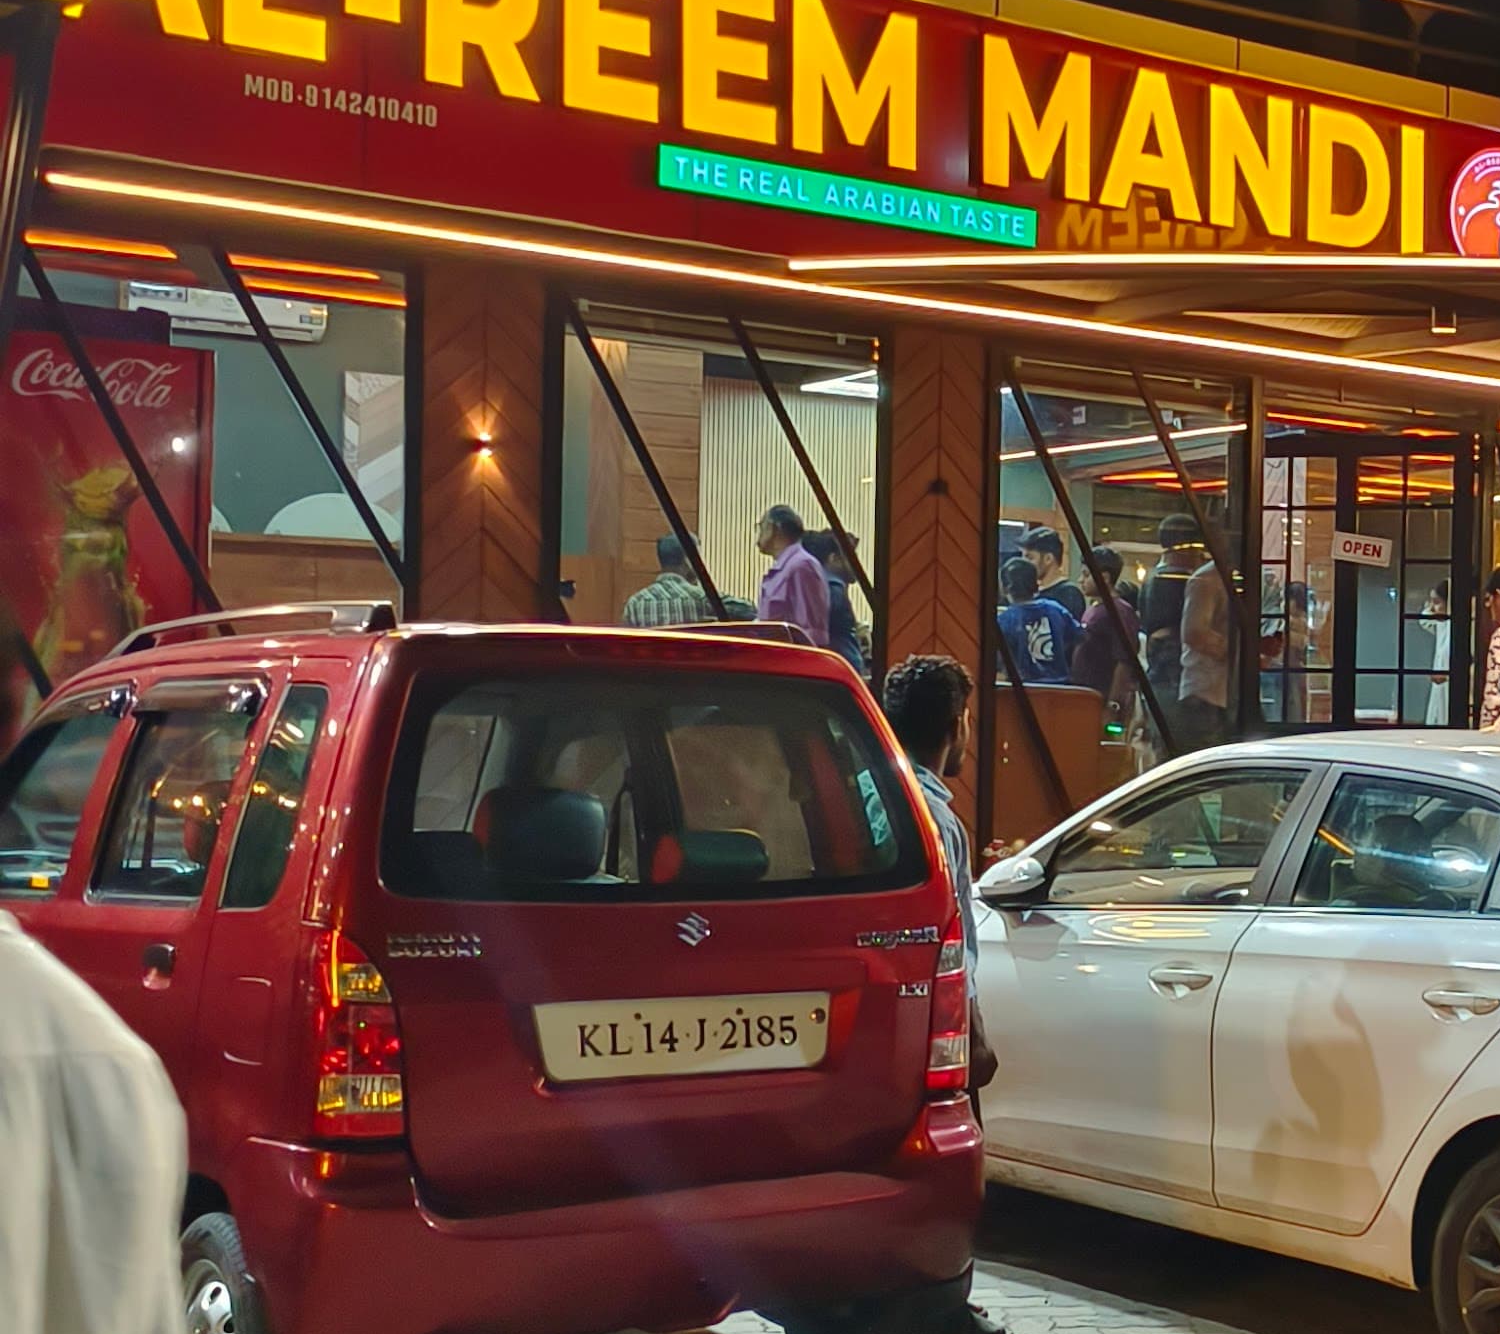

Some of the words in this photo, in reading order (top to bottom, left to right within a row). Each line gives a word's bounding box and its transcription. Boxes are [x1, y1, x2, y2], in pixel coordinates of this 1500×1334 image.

[983, 34, 1425, 254] MANDI
[674, 156, 729, 189] THE
[739, 168, 810, 202] REAL
[824, 183, 941, 224] ARABIAN
[950, 204, 1026, 239] TASTE
[1342, 539, 1383, 559] OPEN
